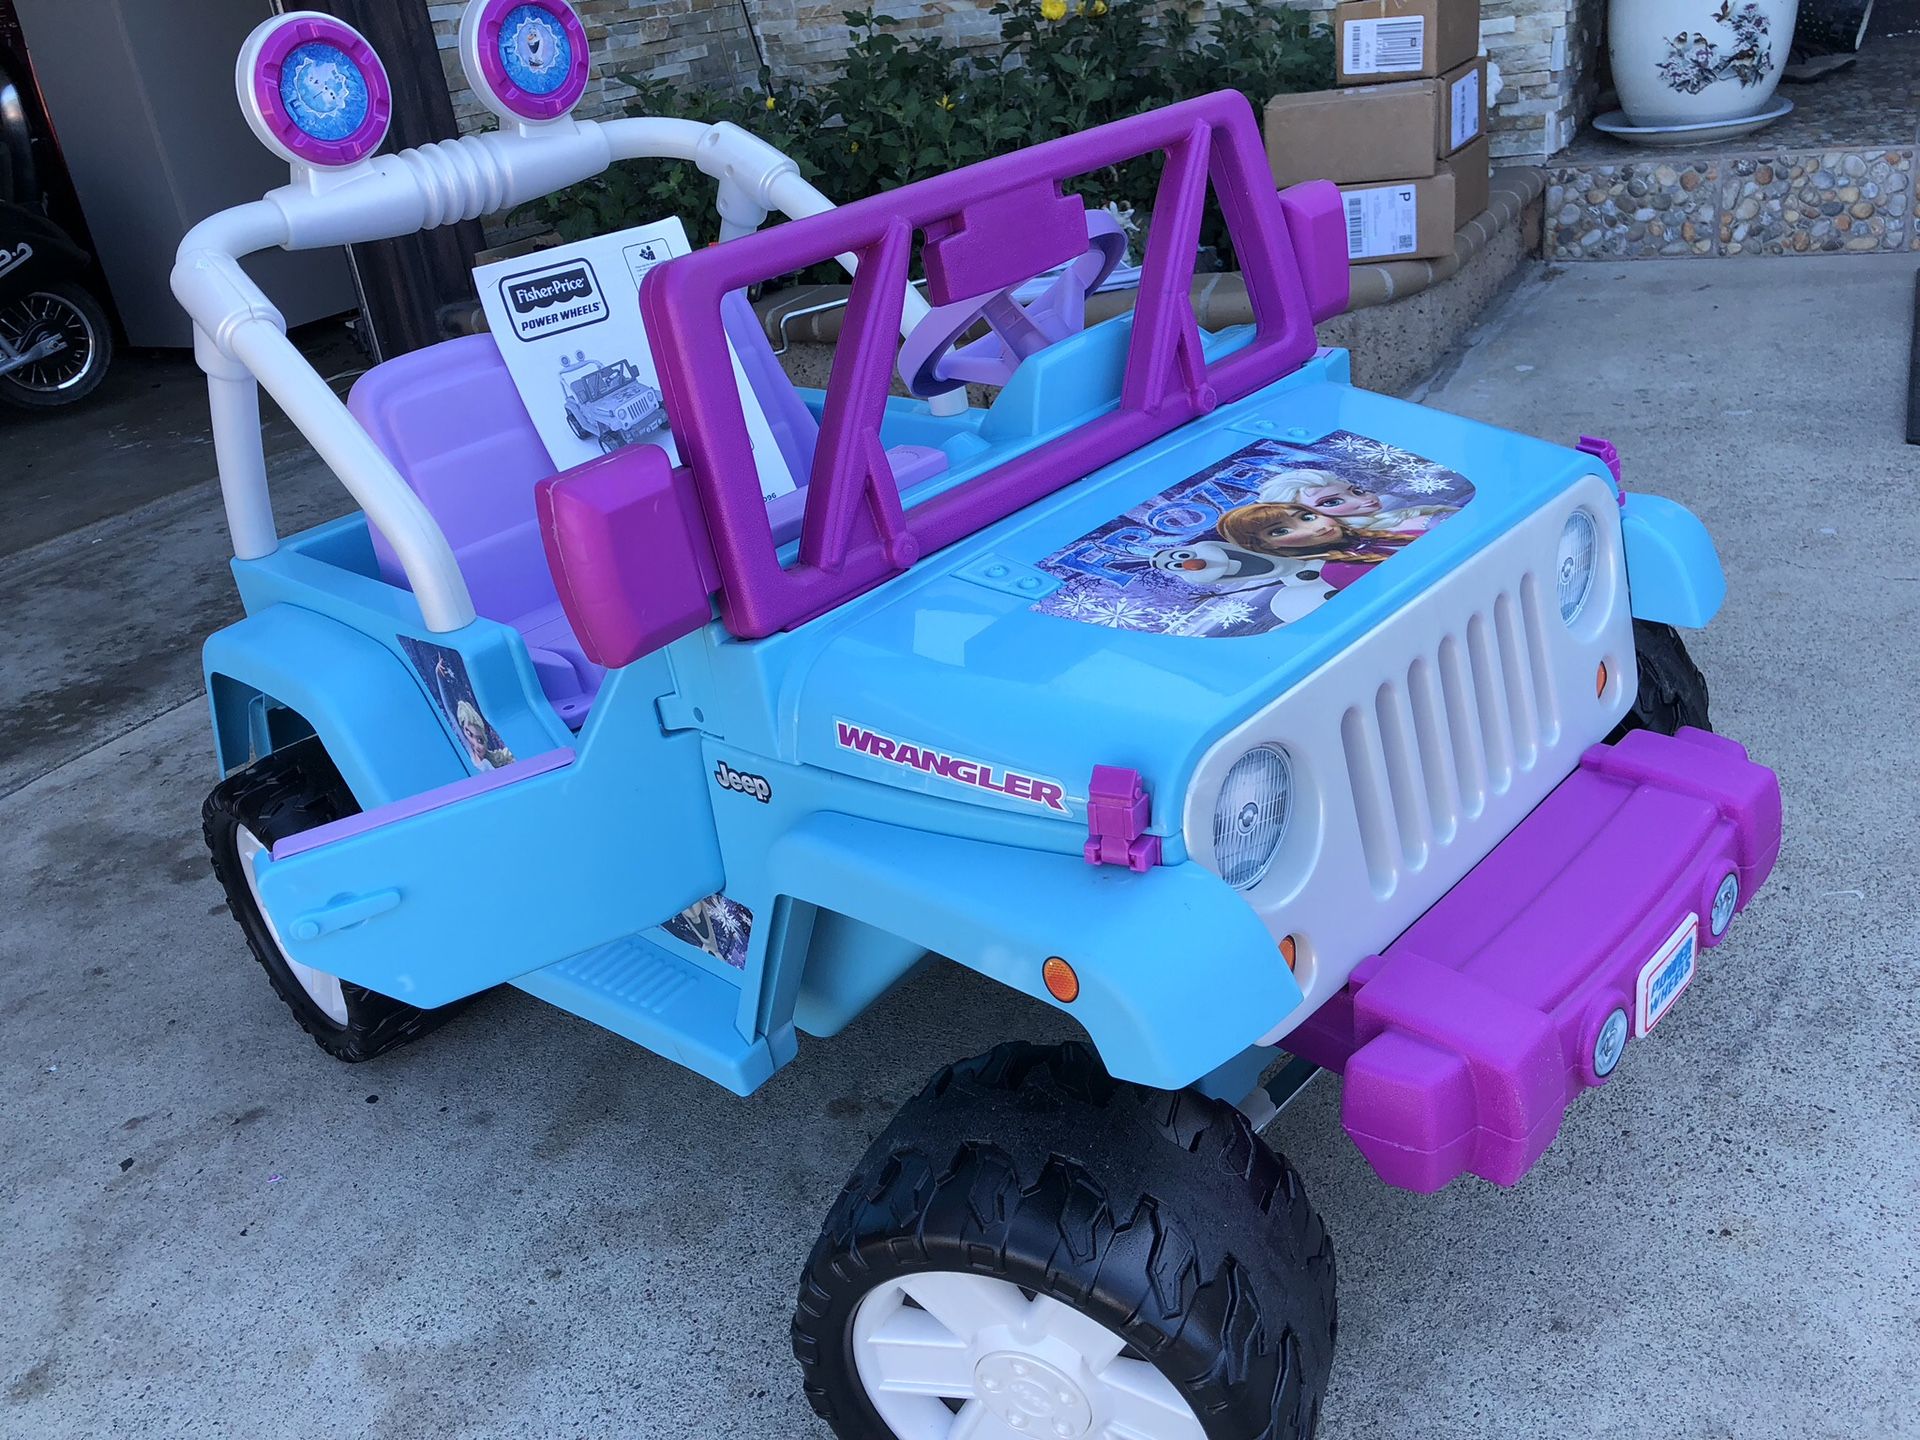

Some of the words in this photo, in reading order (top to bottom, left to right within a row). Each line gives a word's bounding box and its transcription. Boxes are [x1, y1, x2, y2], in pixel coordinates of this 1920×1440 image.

[1398, 191, 1411, 202] P
[516, 277, 584, 304] Fisher-Price
[521, 312, 559, 332] POWER
[560, 302, 600, 321] WHEELS
[715, 762, 771, 803] Jeep
[836, 721, 1067, 812] WRANGLER
[1650, 936, 1693, 999] POWER
[1650, 957, 1691, 1015] WHEELS
